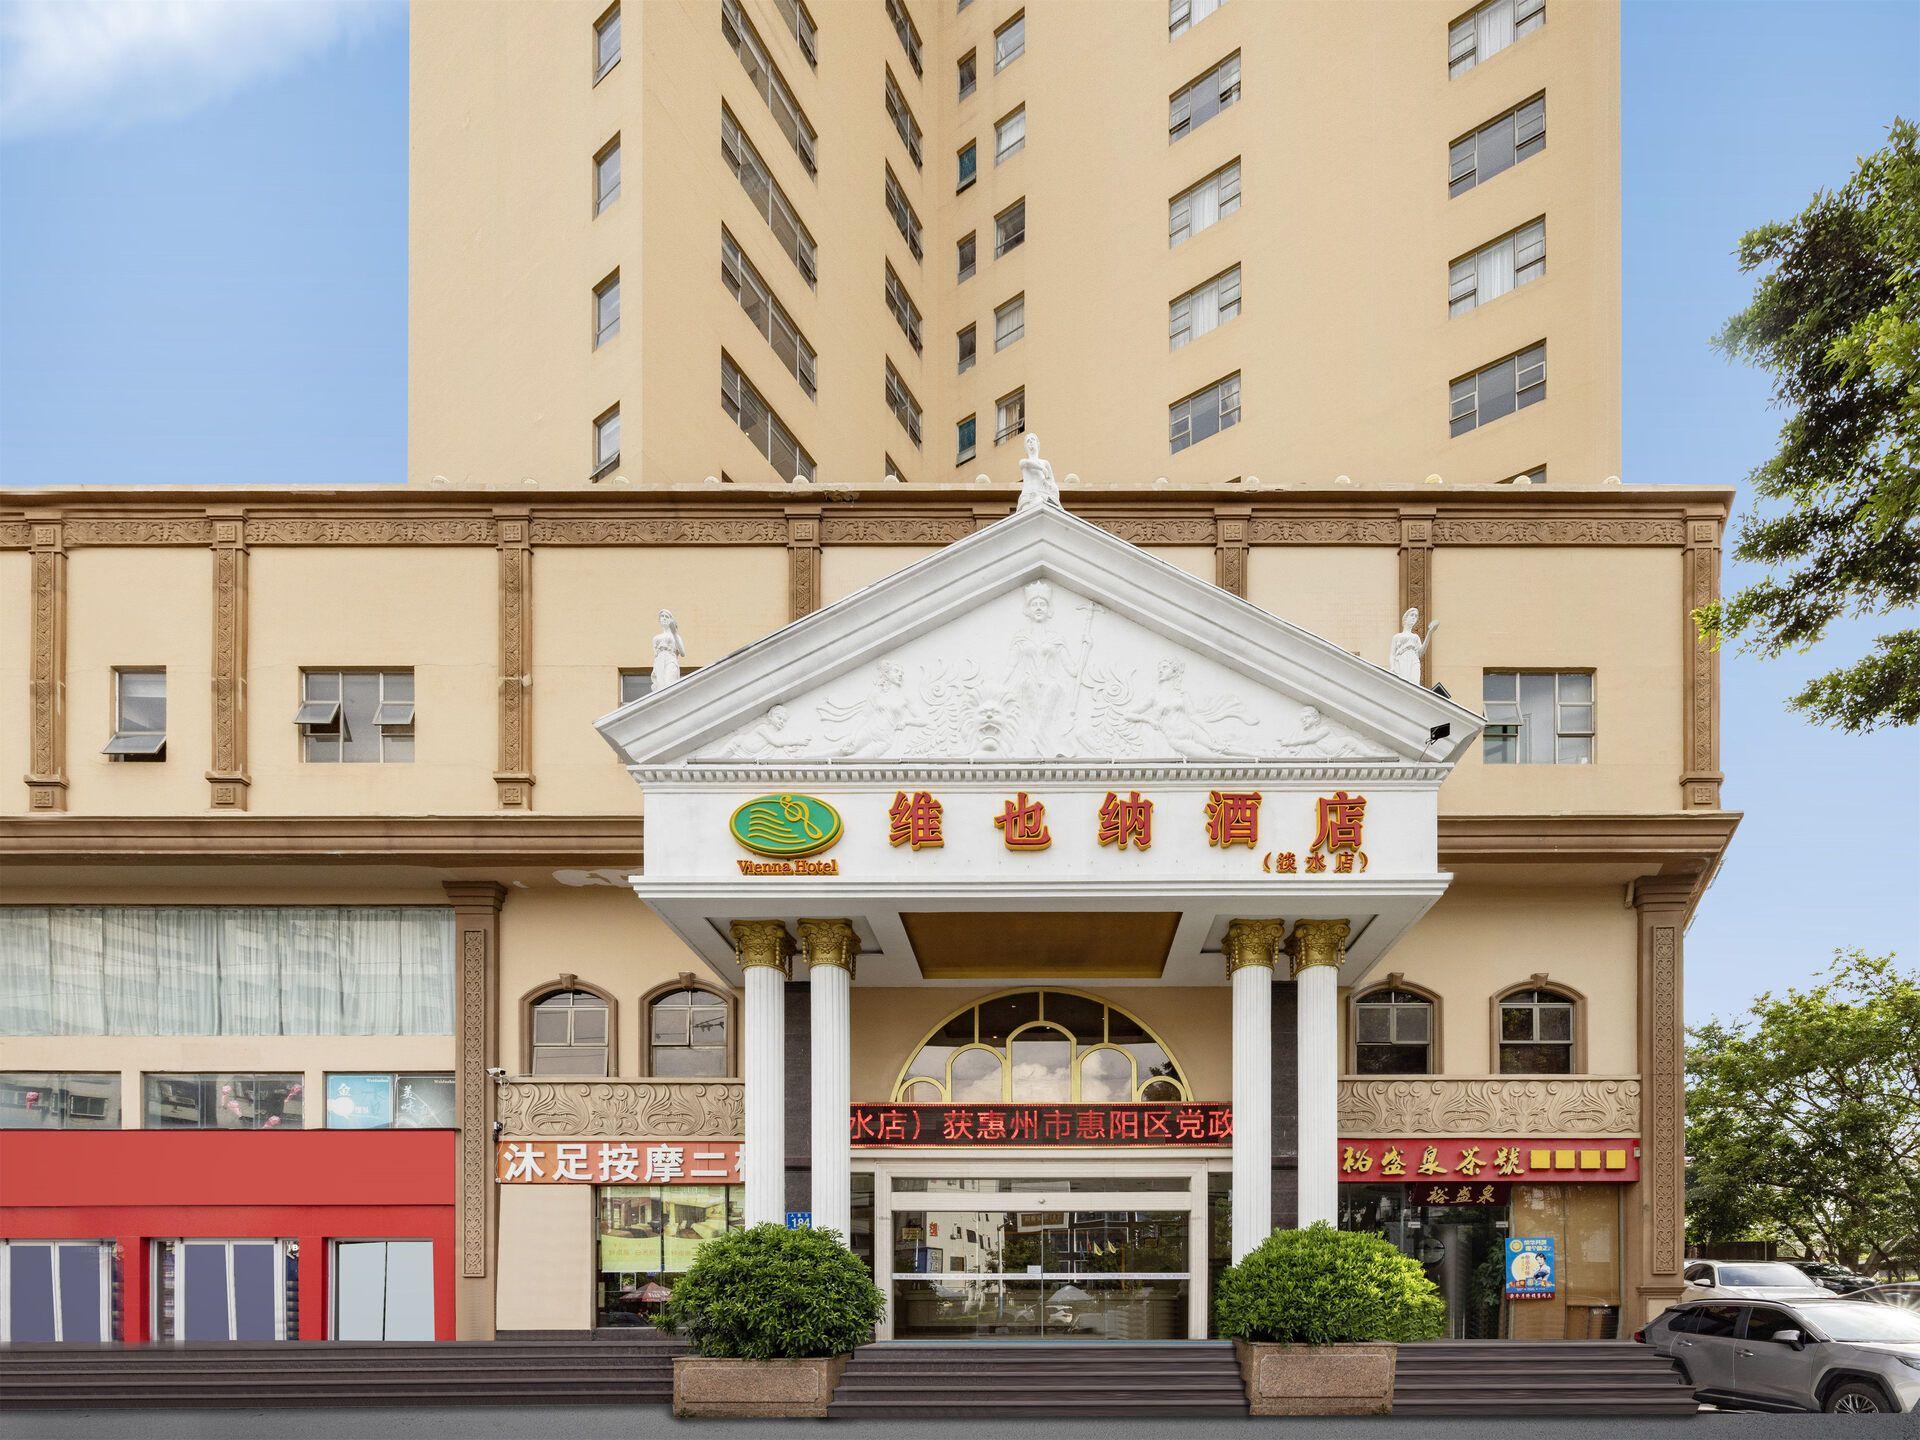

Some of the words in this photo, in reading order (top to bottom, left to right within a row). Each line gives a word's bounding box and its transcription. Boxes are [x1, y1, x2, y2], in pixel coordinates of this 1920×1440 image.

[888, 790, 1367, 851] 维也纳酒店
[737, 858, 793, 876] Vienna
[794, 858, 839, 876] Hotel
[503, 1142, 745, 1182] 沐足按摩二
